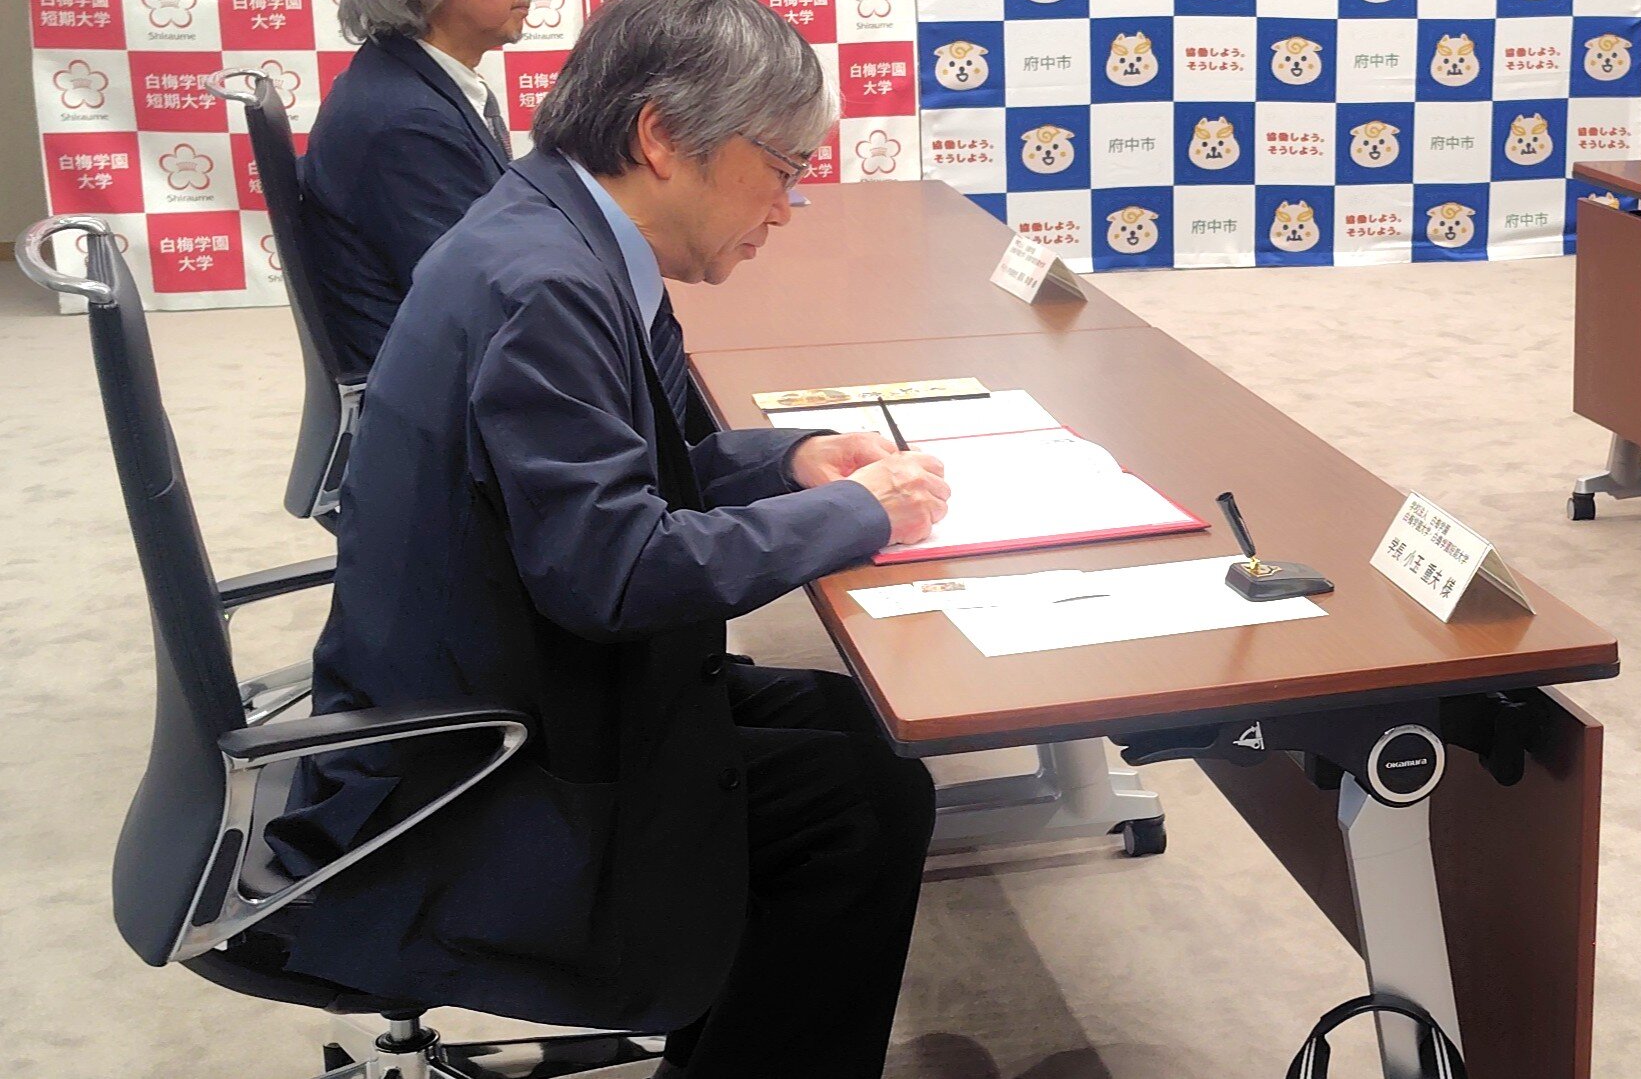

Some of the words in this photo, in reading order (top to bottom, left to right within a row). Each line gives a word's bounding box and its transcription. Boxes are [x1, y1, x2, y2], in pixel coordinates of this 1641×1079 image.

[41, 11, 111, 27] 短期大学
[252, 14, 286, 29] 大学
[856, 22, 893, 30] Shiraume
[148, 32, 196, 40] Shiraume
[1186, 48, 1244, 57] 協働しよう。
[1505, 47, 1560, 57] 協働しよう。
[1024, 55, 1071, 71] 府中市
[1354, 53, 1399, 68] 府中市
[1506, 60, 1558, 70] そうしよう。
[851, 62, 906, 77] 白梅学園
[1187, 62, 1243, 71] そうしよう。
[864, 80, 892, 95] 大学
[61, 113, 109, 121] Shiraume
[1266, 132, 1324, 142] 協働しよう。
[1578, 127, 1631, 136] 協働しよう。
[932, 140, 993, 150] 協働しよう。
[1109, 137, 1155, 153] 府中市
[1431, 136, 1474, 150] 府中市
[1579, 140, 1630, 149] そうしよう。
[1268, 146, 1323, 156] そうしよう。
[60, 153, 129, 170] 白梅学園
[934, 153, 993, 163] そうしよう。
[79, 173, 112, 189] 大学
[1346, 214, 1401, 224] 協働しよう。
[1506, 212, 1548, 228] 府中市
[1019, 221, 1080, 233] 協働しよう。
[1192, 219, 1237, 234] 府中市
[1346, 226, 1402, 237] そうしよう。
[160, 236, 229, 253] 白梅学園
[179, 255, 213, 271] 大学
